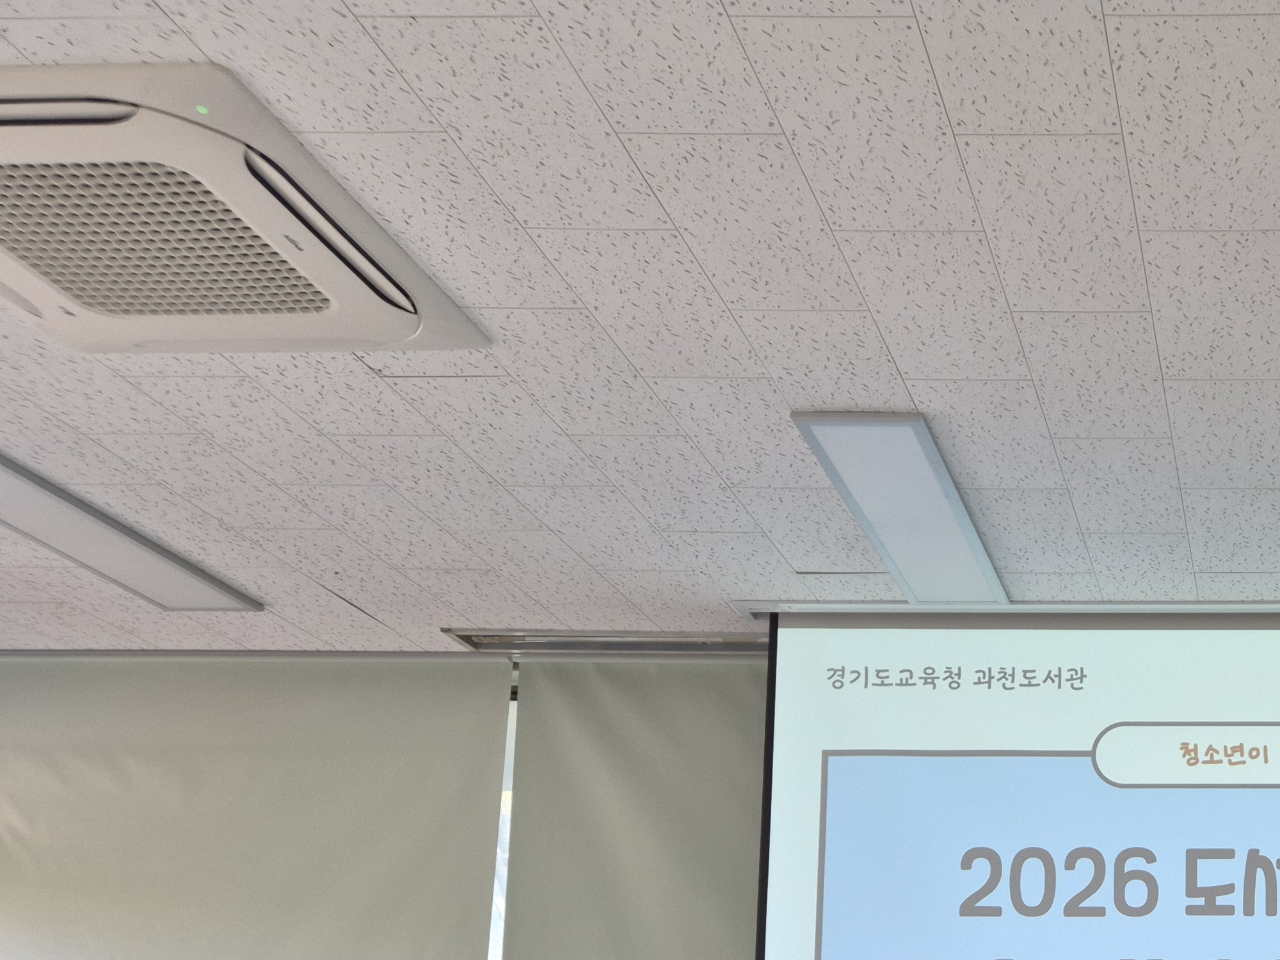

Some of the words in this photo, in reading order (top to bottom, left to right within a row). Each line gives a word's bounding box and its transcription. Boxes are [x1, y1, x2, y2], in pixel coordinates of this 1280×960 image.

[826, 665, 963, 691] 경기도교육청
[972, 666, 1087, 692] 과천도서관
[1179, 742, 1269, 767] 청소년이
[958, 846, 1159, 917] 2026
